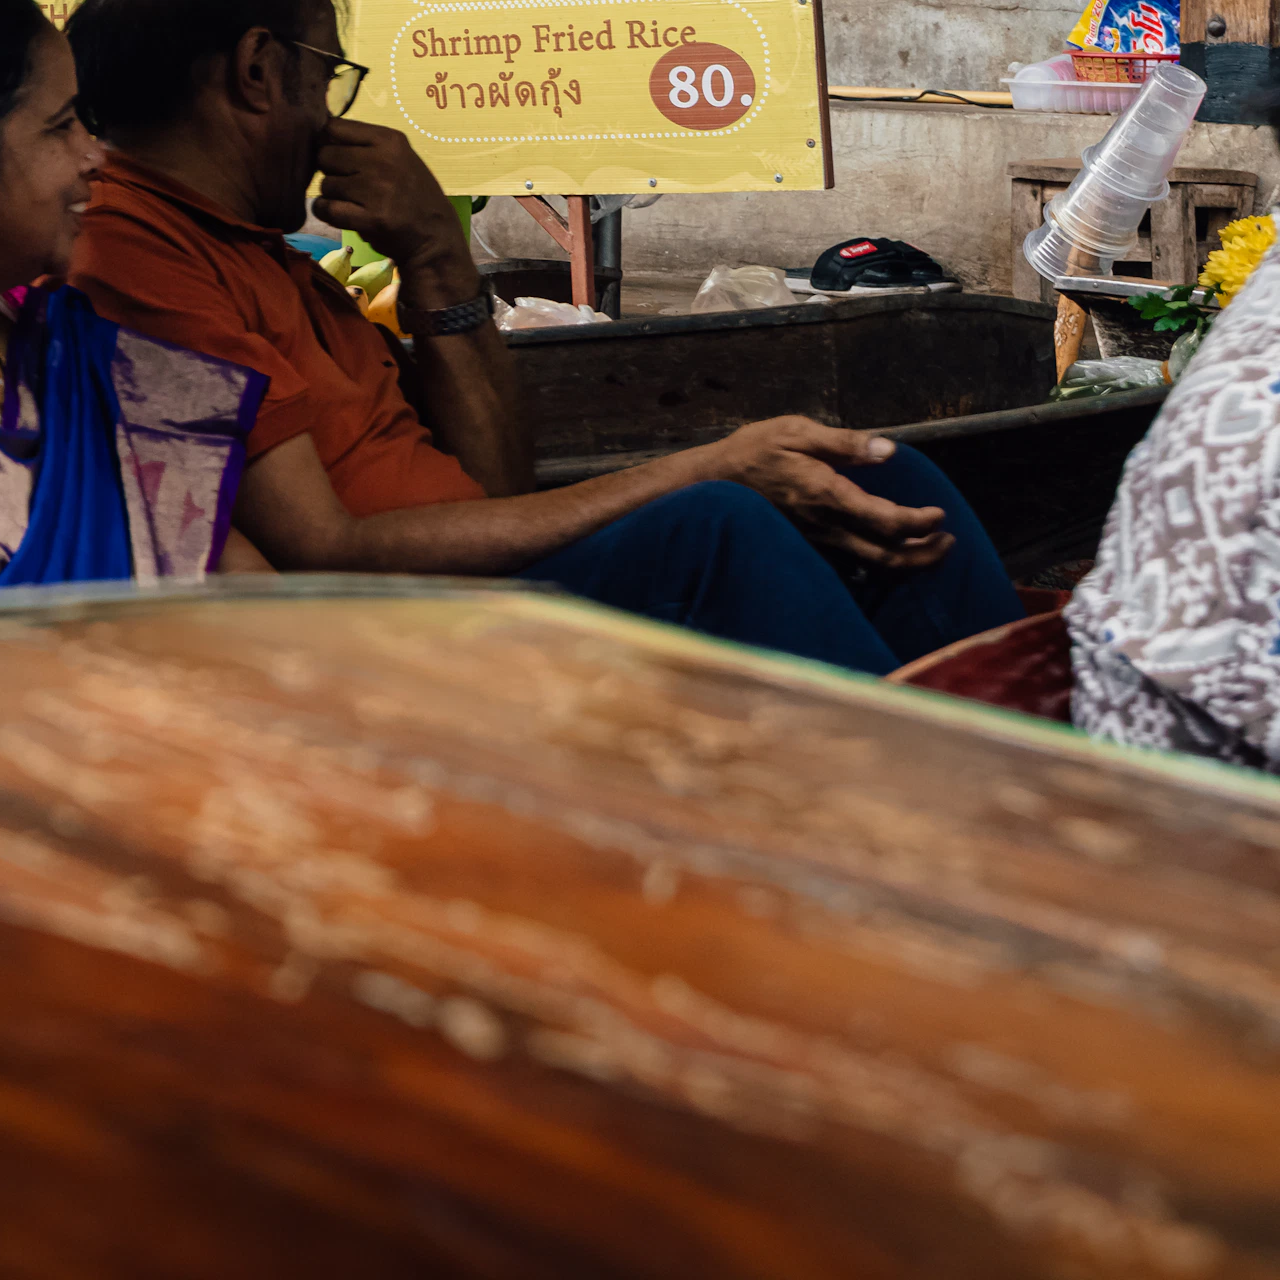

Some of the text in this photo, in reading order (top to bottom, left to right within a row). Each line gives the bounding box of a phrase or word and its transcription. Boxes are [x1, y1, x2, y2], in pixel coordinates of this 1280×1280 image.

[411, 19, 697, 64] Shrimp Fried Rice
[425, 68, 582, 119] ข้าวผัดกุ้ง
[668, 63, 753, 109] 80.
